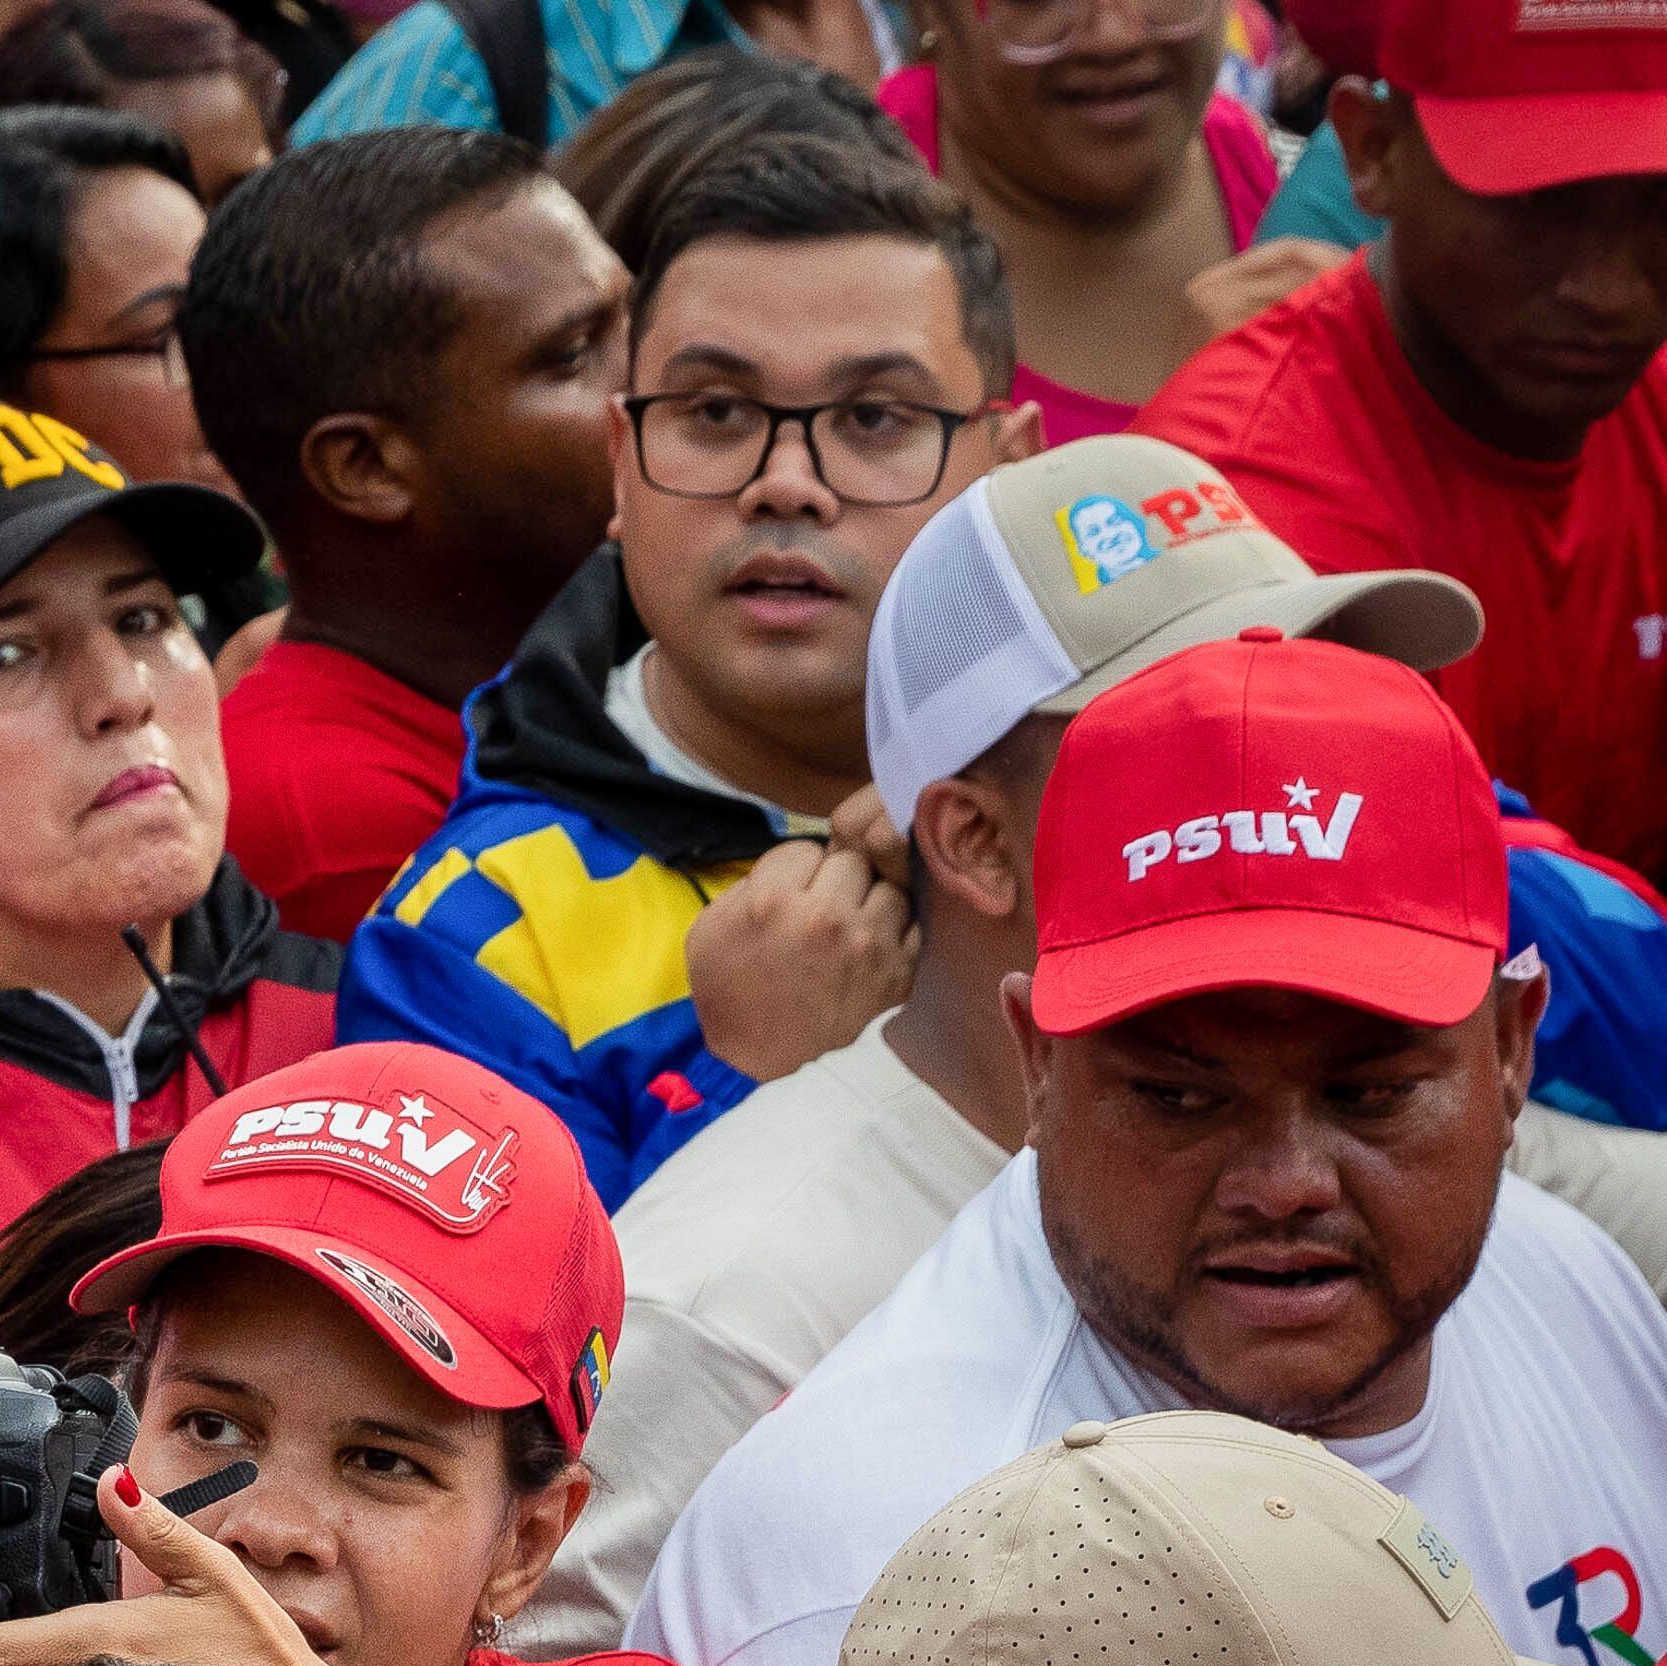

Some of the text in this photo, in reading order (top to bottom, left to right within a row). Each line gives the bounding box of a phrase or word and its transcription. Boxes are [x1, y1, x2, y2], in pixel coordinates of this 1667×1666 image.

[310, 1139, 348, 1156] Unido
[348, 1147, 365, 1160] de
[367, 1152, 428, 1191] Venezuela
